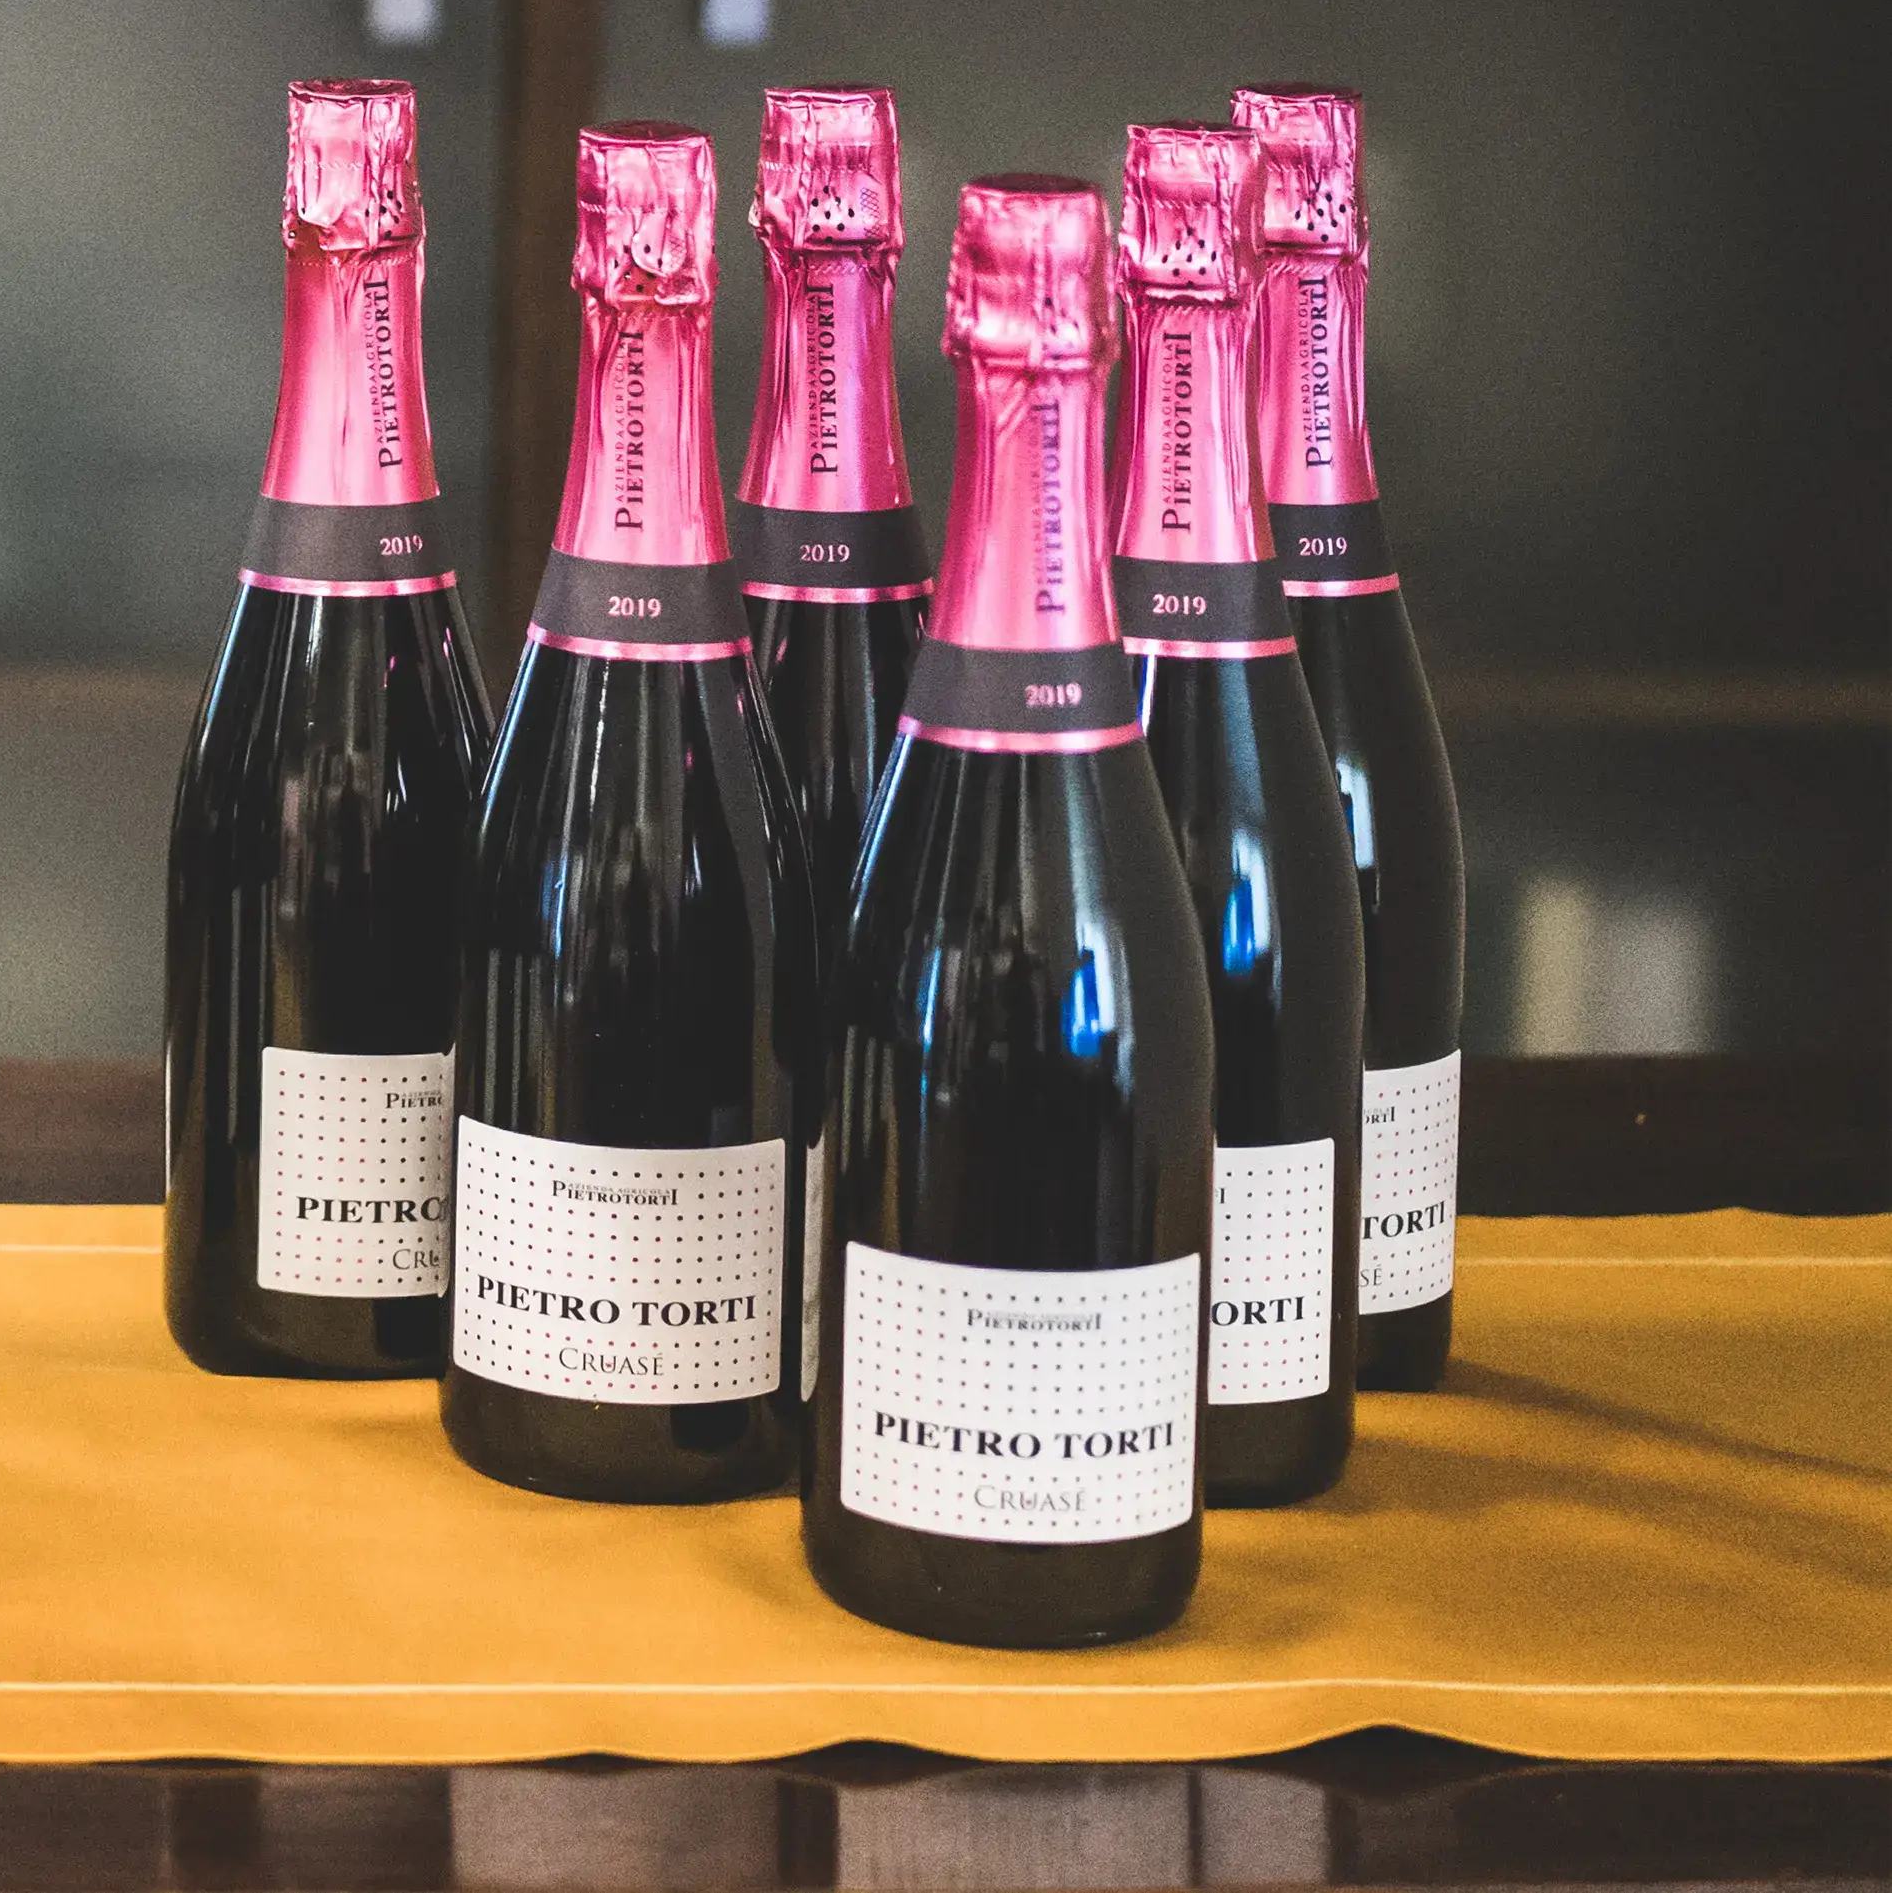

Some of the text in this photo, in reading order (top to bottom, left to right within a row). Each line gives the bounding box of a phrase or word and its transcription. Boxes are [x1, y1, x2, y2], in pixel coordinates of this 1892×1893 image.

[365, 280, 402, 468] PIETROTORTI
[806, 283, 838, 474] PIETROTORTI
[1298, 275, 1332, 468] PIETROTORTI
[615, 331, 644, 532] PIETROTORTI
[1162, 331, 1192, 532] PIETROTORTI
[379, 535, 423, 556] 2019
[799, 543, 850, 564] 2019
[1299, 537, 1348, 558] 2019
[608, 596, 661, 619] 2019
[1152, 594, 1206, 616] 2019
[1025, 683, 1082, 707] 2019
[552, 1180, 678, 1205] PIETROTORTI
[1362, 1201, 1445, 1240] TORTI
[477, 1274, 757, 1327] PIETRO TORTI
[558, 1347, 665, 1378] CRUASÉ
[874, 1410, 1174, 1459] PIETRO TORTI
[973, 1484, 1087, 1513] CRUASÉ
